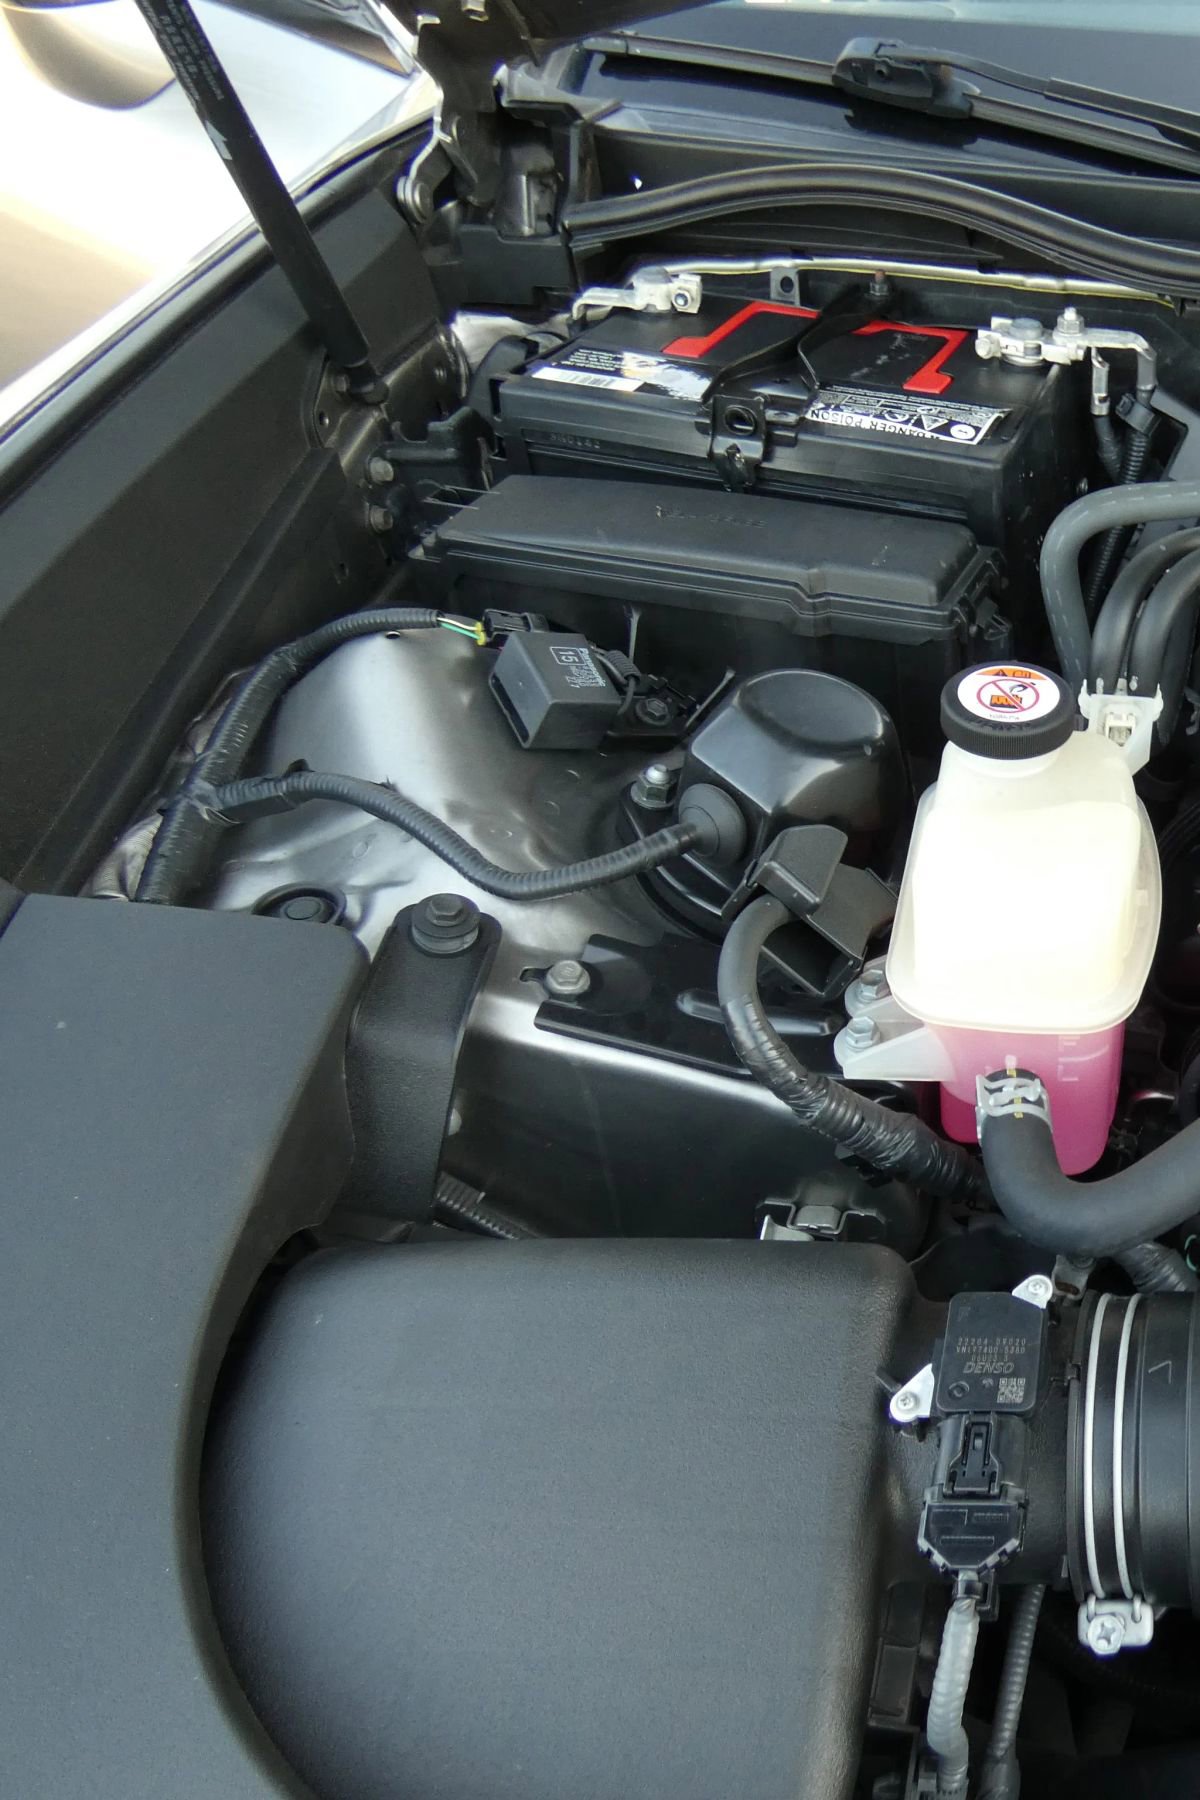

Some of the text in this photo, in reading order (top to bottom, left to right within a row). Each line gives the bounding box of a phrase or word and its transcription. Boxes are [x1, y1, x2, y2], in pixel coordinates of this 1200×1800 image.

[811, 410, 862, 427] POISON
[559, 651, 579, 662] 15
[578, 648, 605, 687] Panasonic
[963, 1361, 1014, 1374] DENSO
